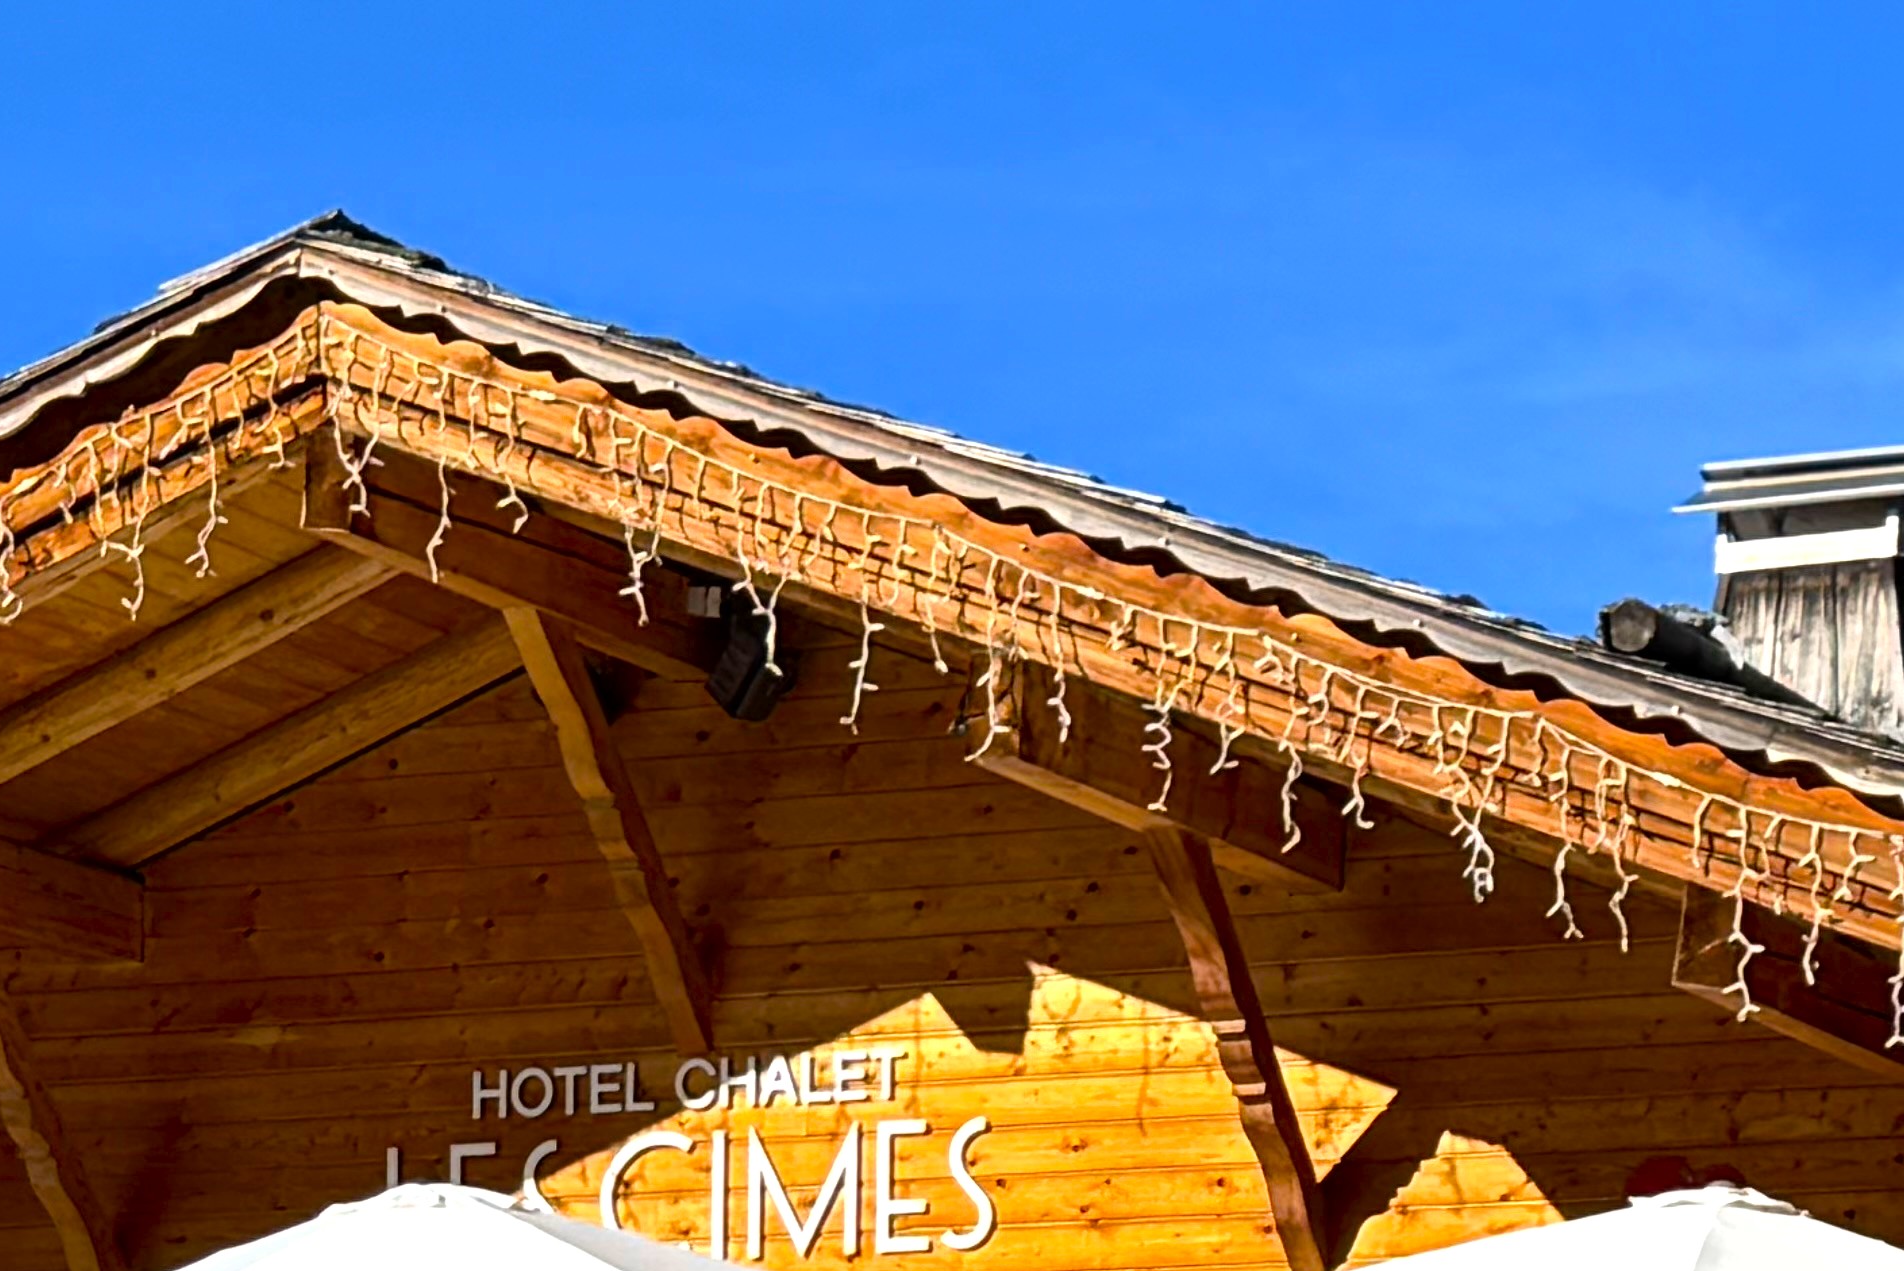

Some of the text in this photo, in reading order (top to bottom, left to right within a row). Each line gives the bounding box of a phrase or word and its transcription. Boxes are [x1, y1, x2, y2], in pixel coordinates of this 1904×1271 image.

[472, 1050, 907, 1120] HOTEL CHALET
[599, 1116, 996, 1260] CIMES
